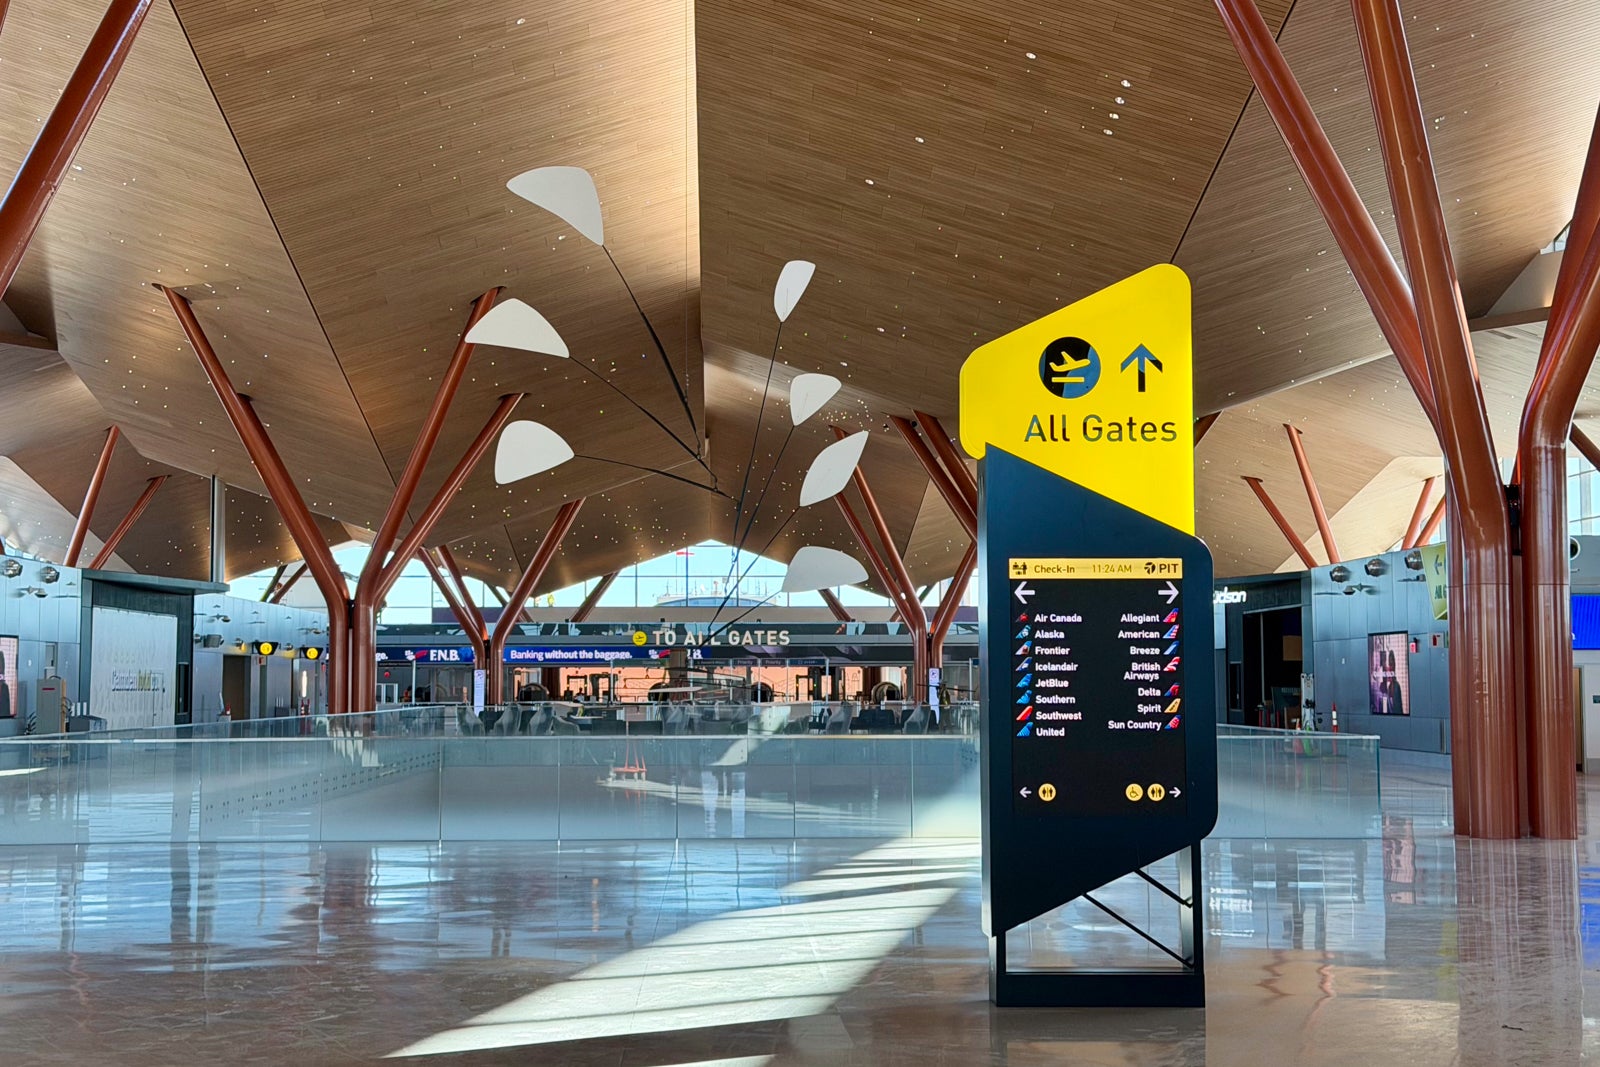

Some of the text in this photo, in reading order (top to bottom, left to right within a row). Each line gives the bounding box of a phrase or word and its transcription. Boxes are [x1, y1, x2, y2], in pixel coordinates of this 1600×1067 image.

[1024, 414, 1177, 443] All Gates
[1034, 563, 1179, 574] Check-In 11:24 AM PIT
[1034, 613, 1082, 623] Air Canada
[1120, 613, 1160, 625] Allegiant
[652, 630, 790, 646] TO ALL GATES
[1034, 629, 1065, 639] Alaska
[1117, 629, 1160, 639] American
[1034, 645, 1071, 655] Frontier
[1129, 645, 1160, 655] Breeze
[510, 649, 633, 662] Banking without the baggage.
[1035, 661, 1079, 671] Icelandair
[1131, 661, 1161, 671] British
[1123, 671, 1160, 681] Airways
[1035, 678, 1069, 688] JetBlue
[1137, 687, 1161, 697] Delta
[1035, 694, 1076, 704] Southern
[1137, 703, 1162, 714] Spirit
[1035, 711, 1082, 721] Southwest
[1107, 720, 1162, 731] Sun Country
[1035, 727, 1065, 737] United
